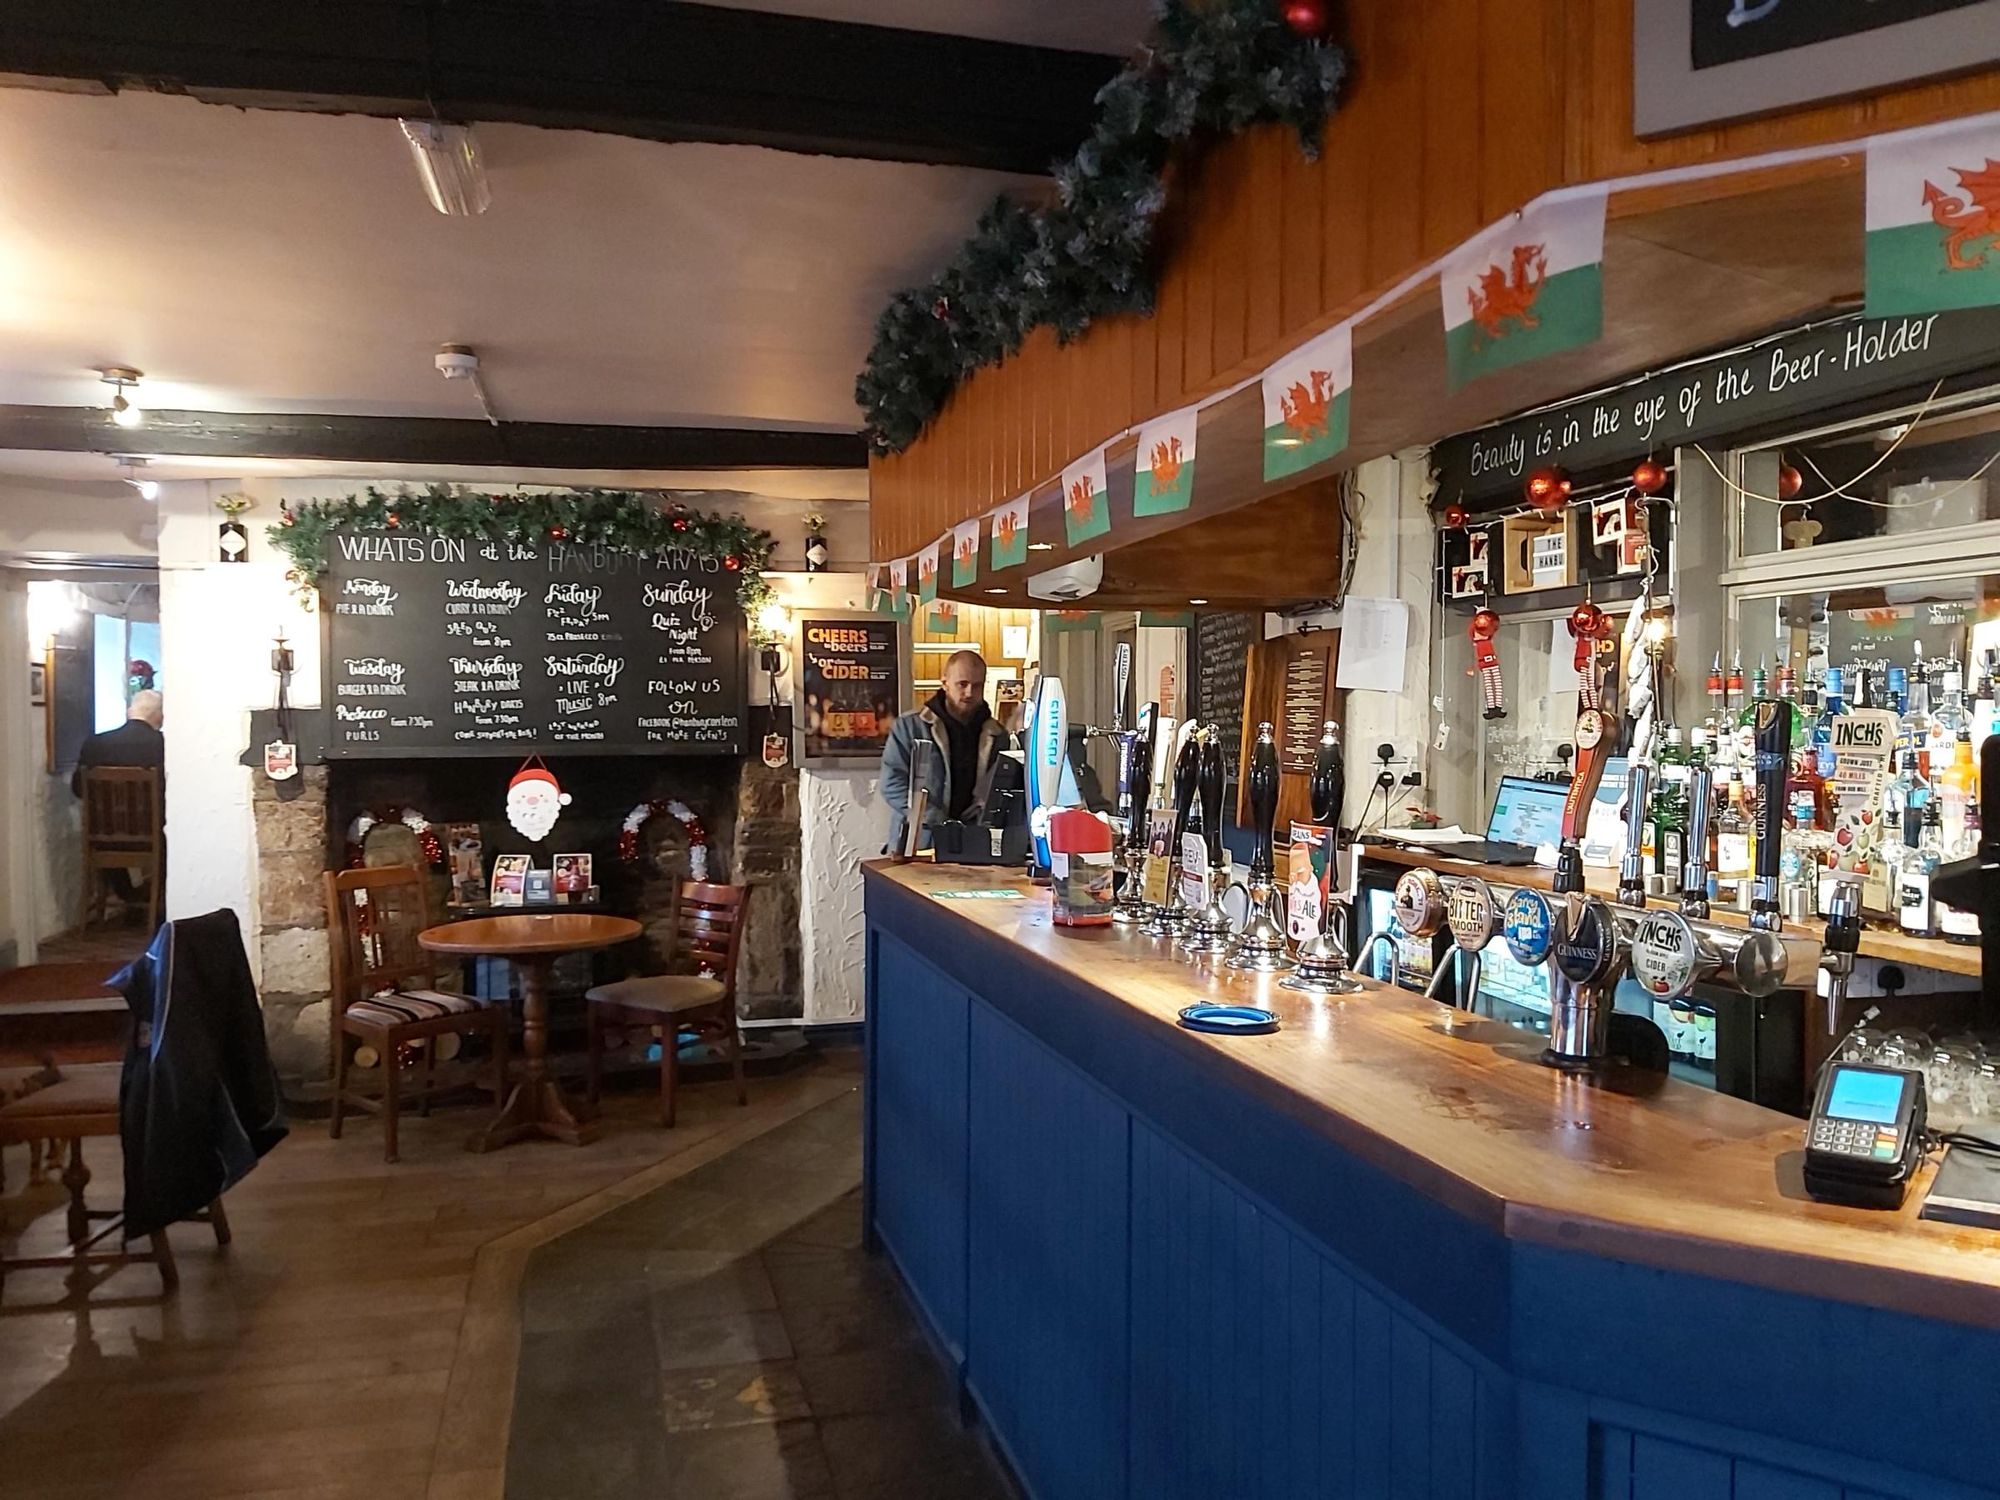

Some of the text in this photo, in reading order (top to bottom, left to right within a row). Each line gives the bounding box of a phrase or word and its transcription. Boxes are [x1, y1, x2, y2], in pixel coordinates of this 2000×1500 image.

[1471, 433, 1525, 476] Beauty
[1536, 422, 1552, 456] is
[1593, 406, 1620, 438] the
[1634, 395, 1667, 442] eye
[1679, 380, 1702, 428] of
[1716, 366, 1754, 405] the
[1547, 538, 1562, 550] THE
[338, 535, 425, 562] WHATS
[430, 538, 465, 562] ON
[480, 542, 499, 561] at
[507, 544, 539, 561] the
[656, 550, 720, 573] ARMS
[1539, 554, 1563, 567] HANBU
[446, 579, 528, 609] Wednesday
[544, 583, 602, 617] Friday
[642, 580, 712, 622] Sunday
[367, 604, 394, 616] DRINK
[652, 612, 681, 630] Quiz
[669, 628, 698, 645] Night
[807, 628, 868, 643] CHEERS
[831, 641, 868, 653] beers
[344, 657, 405, 684] Tuesday
[449, 655, 523, 681] Thursday
[544, 653, 625, 687] Saturday
[818, 658, 835, 668] or
[822, 665, 869, 680] CIDER
[567, 680, 590, 694] LIVE
[648, 679, 721, 695] FOLLOW US
[666, 730, 689, 740] MORE
[695, 729, 727, 740] EVENTS
[1757, 783, 1766, 841] GUINNESS
[1301, 899, 1317, 920] ALE
[1449, 898, 1483, 920] BITTER
[1450, 920, 1484, 932] SMOOTH
[1557, 943, 1597, 960] GUINNESS
[1646, 958, 1666, 972] CIDER
